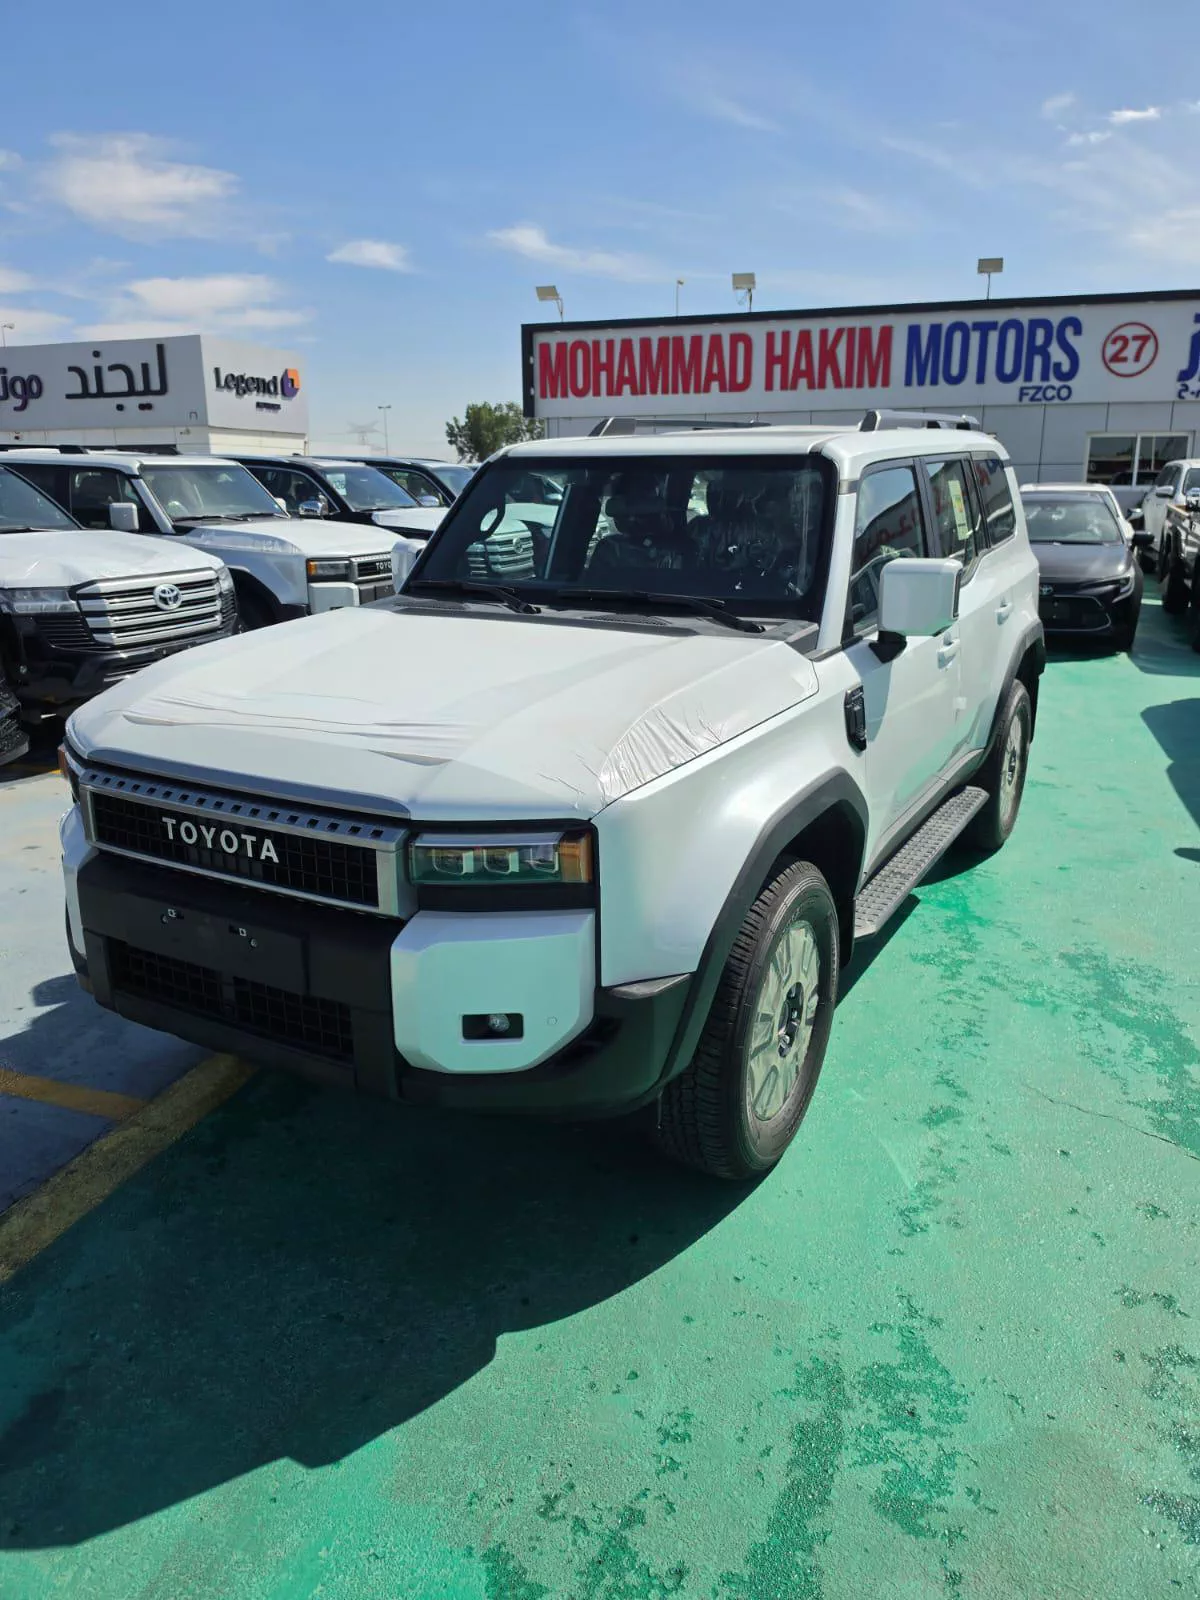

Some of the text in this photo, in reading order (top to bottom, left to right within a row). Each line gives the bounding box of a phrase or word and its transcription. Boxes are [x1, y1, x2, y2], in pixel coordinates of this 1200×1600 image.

[538, 316, 1083, 400] MOHAMMAD HAKIM MOTORS
[1108, 334, 1151, 364] 27
[65, 343, 168, 412] ليجند
[214, 366, 279, 398] Legend
[1018, 384, 1073, 403] FZCO
[162, 816, 279, 863] TOYOTA
